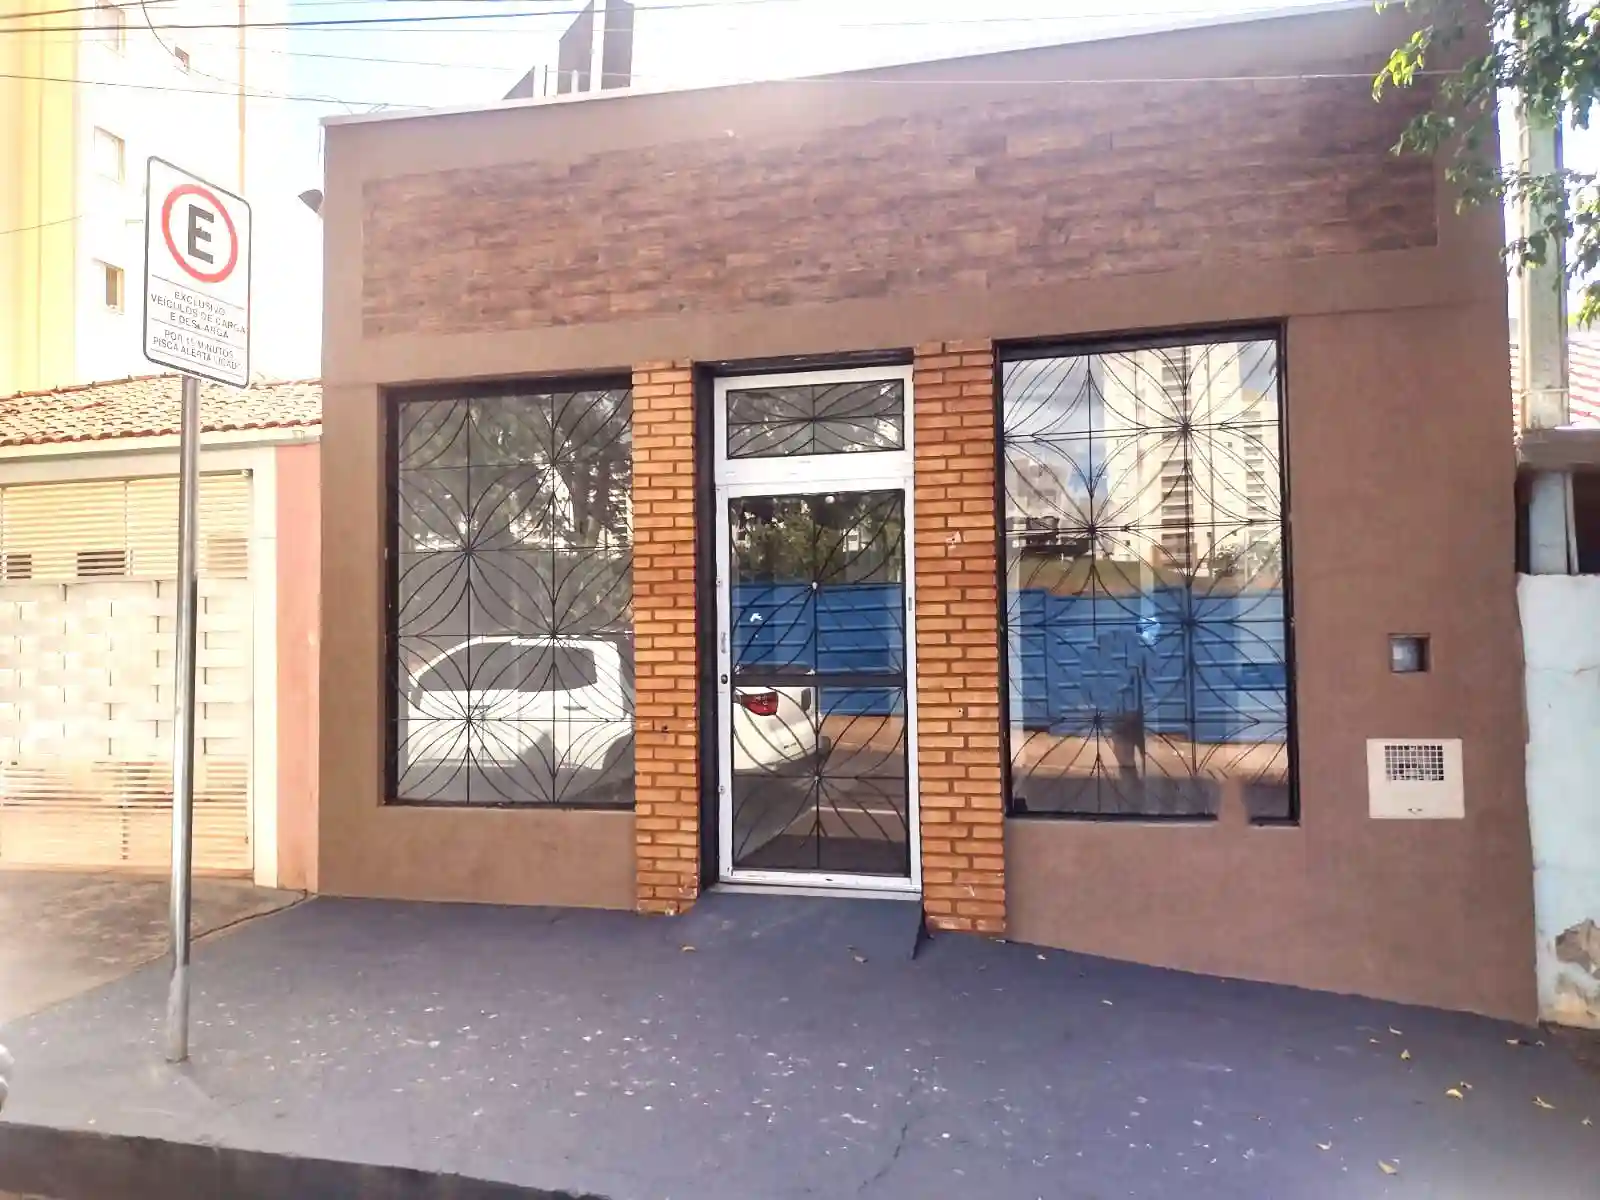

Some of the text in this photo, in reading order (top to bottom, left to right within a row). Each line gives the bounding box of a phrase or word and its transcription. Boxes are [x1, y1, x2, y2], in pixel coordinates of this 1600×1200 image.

[188, 204, 214, 264] E
[150, 293, 246, 334] VEÍCULOS DE CARGA
[169, 311, 176, 321] E
[174, 291, 226, 316] EXCLUSIVO
[152, 336, 178, 351] PISCA
[213, 354, 241, 370] LIGAD
